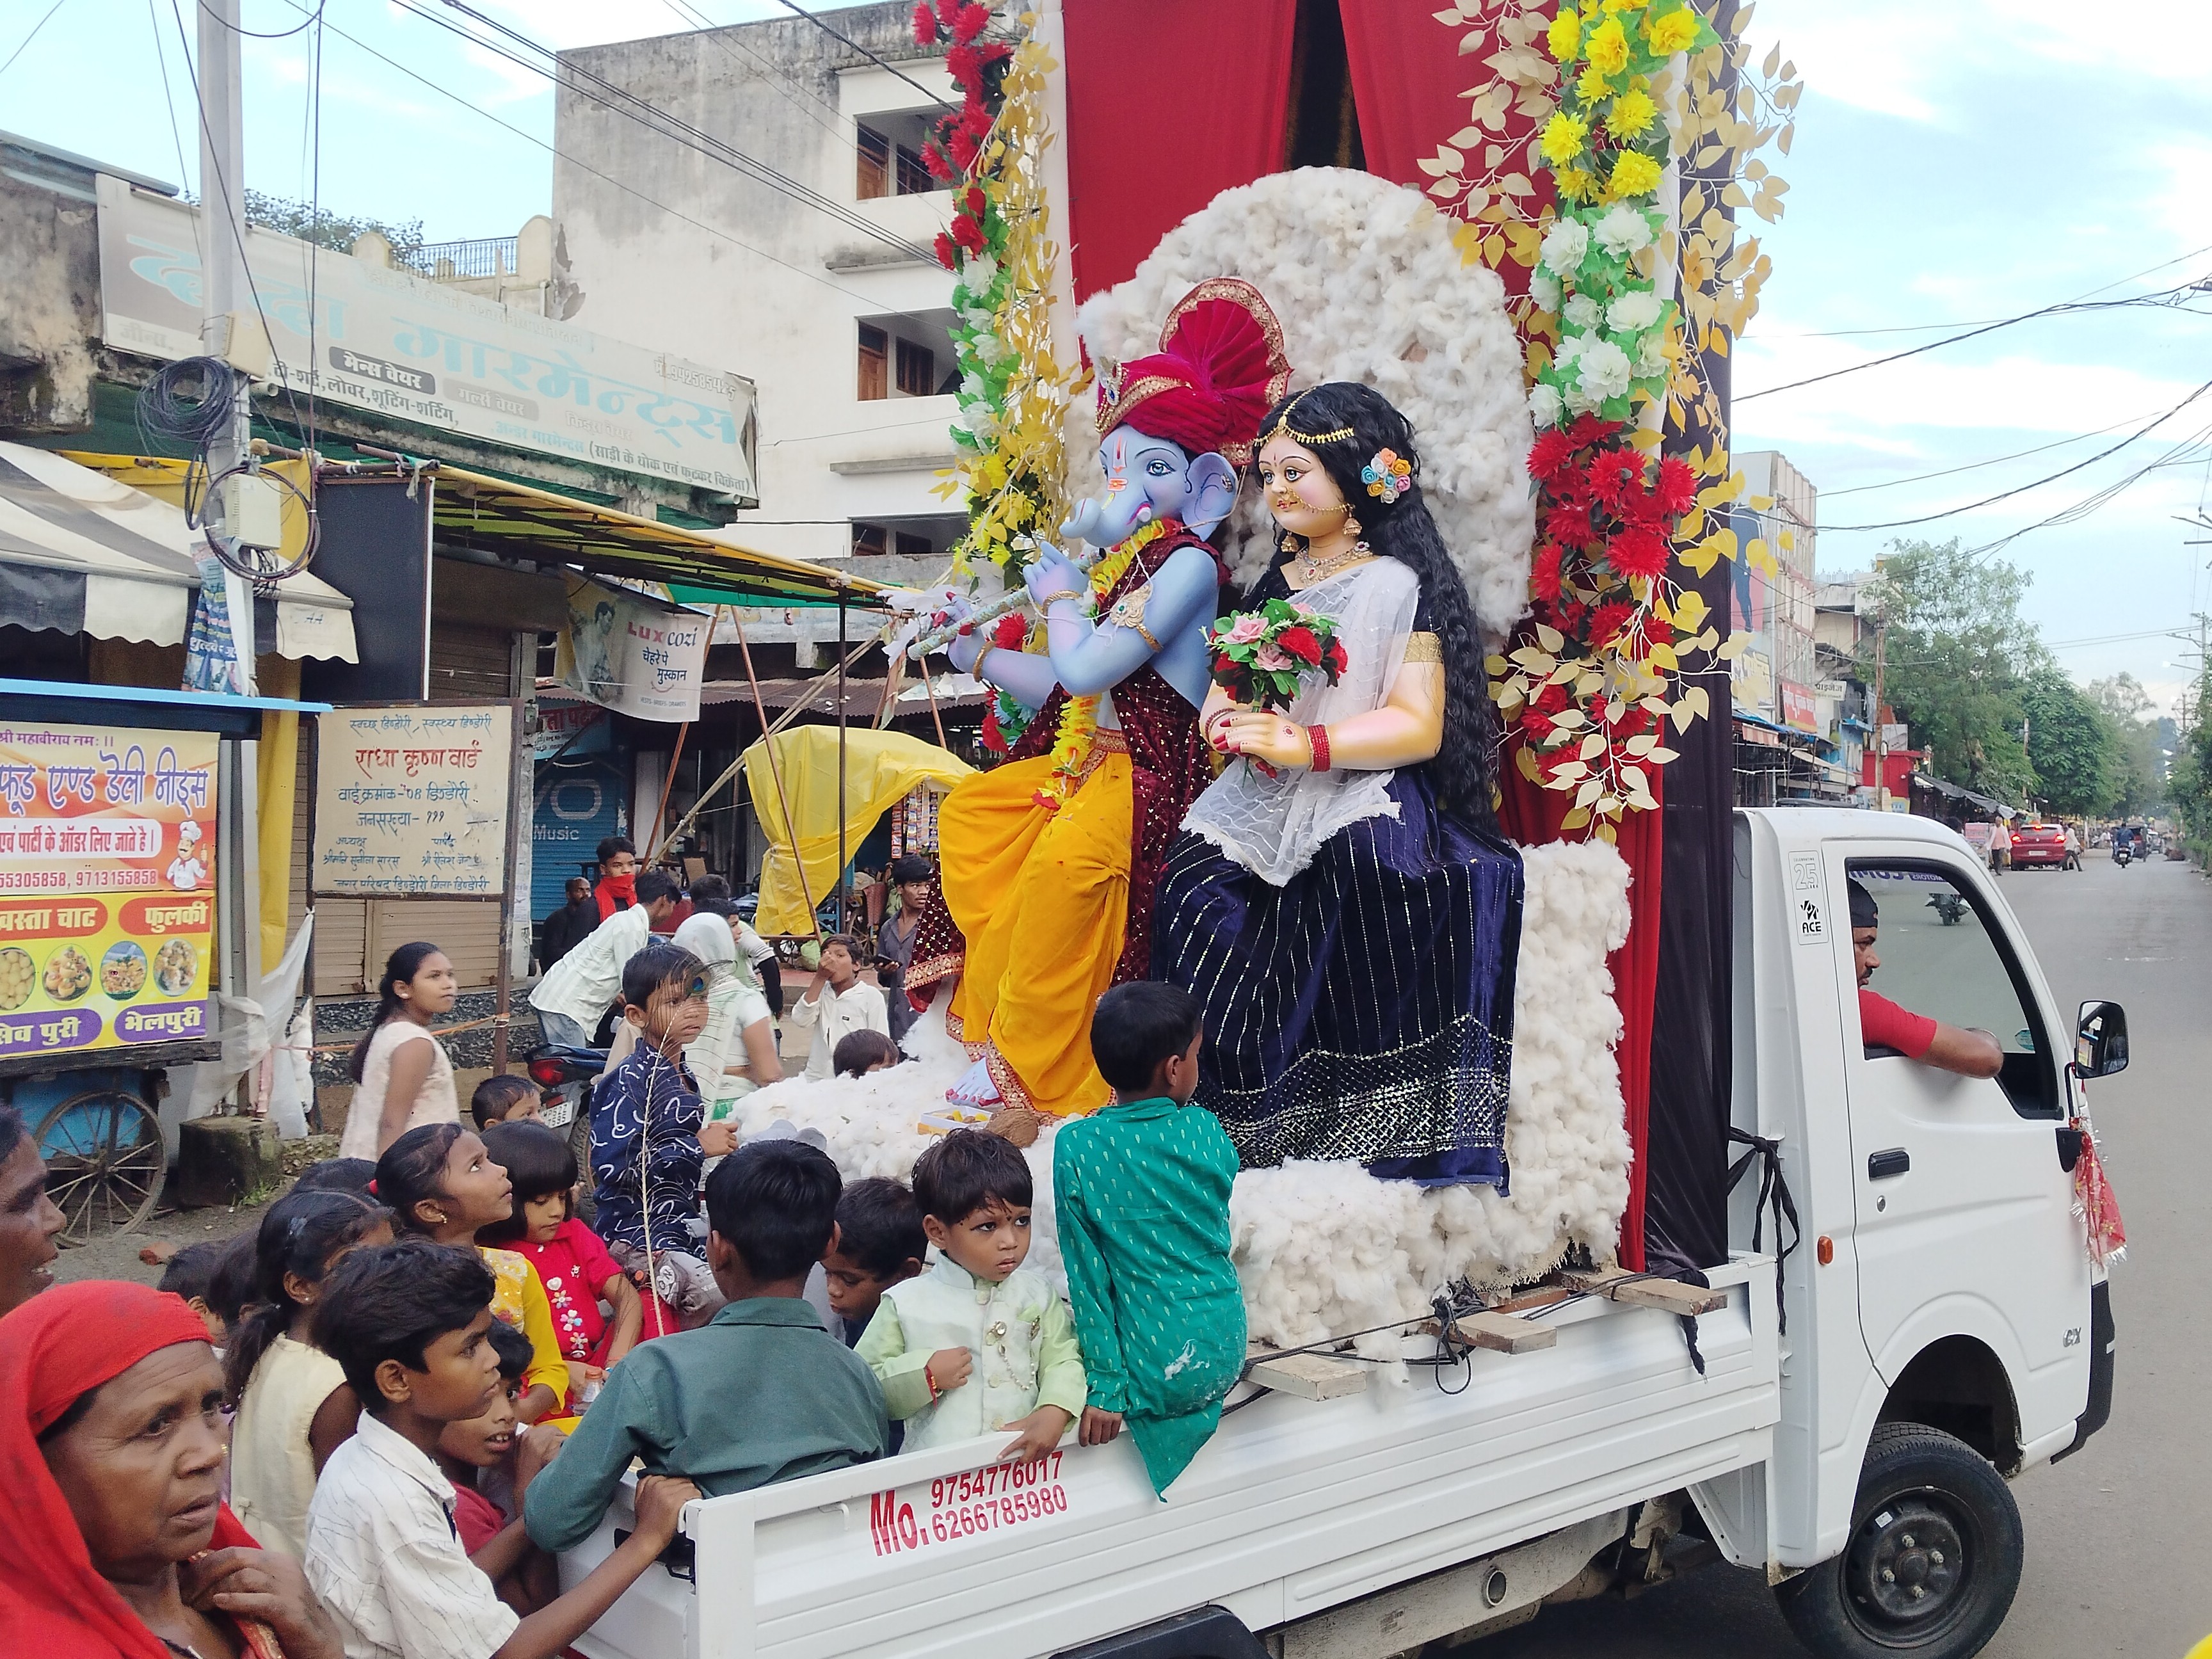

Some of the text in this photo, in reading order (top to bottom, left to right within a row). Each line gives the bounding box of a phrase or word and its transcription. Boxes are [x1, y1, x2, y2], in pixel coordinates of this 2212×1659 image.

[343, 351, 422, 389] मेन्स वेयर
[496, 394, 525, 416] वेयर
[623, 450, 634, 465] के
[643, 646, 669, 666] चेहरे पे
[657, 668, 687, 685] मुस्कान
[355, 739, 482, 780] राधा कृष्ण वार्ड
[45, 825, 56, 853] के
[90, 825, 112, 853] लिए
[115, 825, 136, 852] जाते
[533, 824, 579, 841] Music
[76, 869, 157, 886] 9713155858
[1794, 863, 1818, 890] 25
[58, 906, 98, 929] चाट
[145, 901, 209, 933] फुलकी
[1802, 922, 1822, 934] ACE
[40, 1016, 82, 1046] पुरी
[124, 1006, 204, 1034] भेलपुरी
[931, 1450, 1063, 1509] 9754776017
[870, 1489, 930, 1557] Mo.
[931, 1484, 1068, 1543] 6266785980
